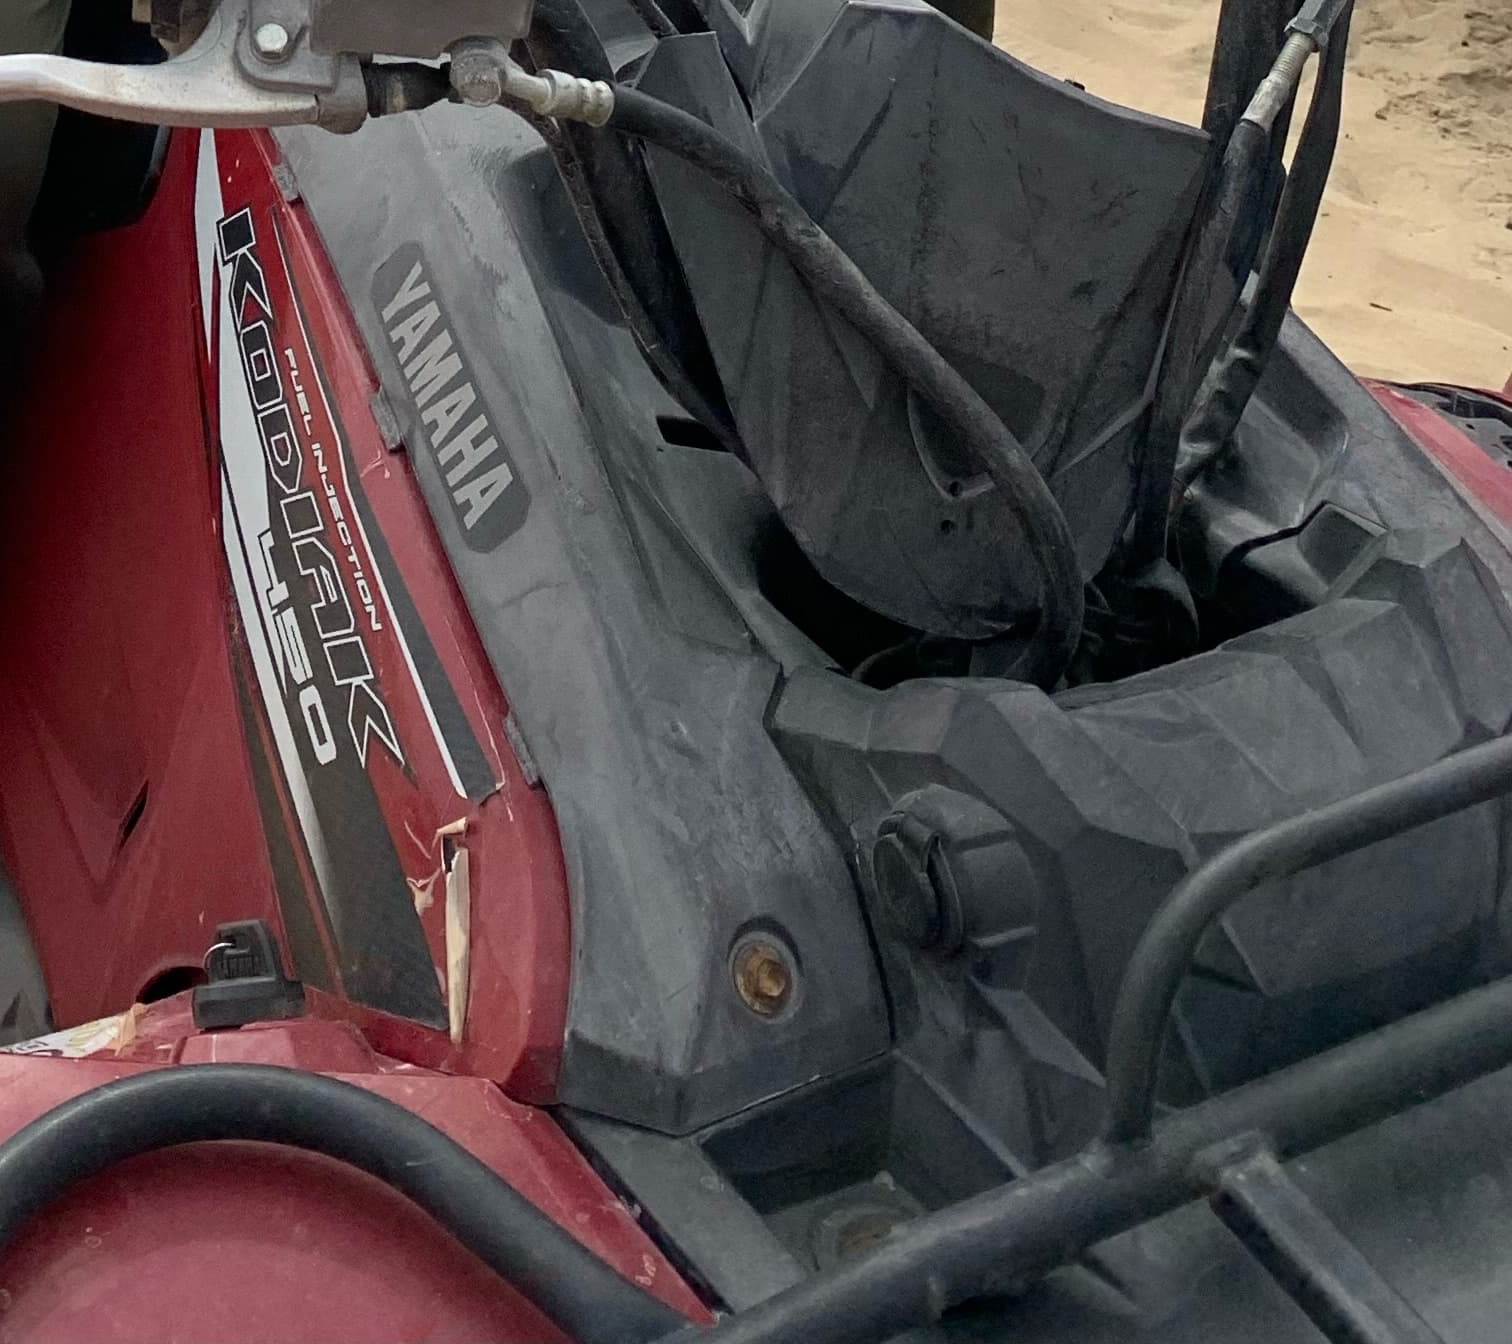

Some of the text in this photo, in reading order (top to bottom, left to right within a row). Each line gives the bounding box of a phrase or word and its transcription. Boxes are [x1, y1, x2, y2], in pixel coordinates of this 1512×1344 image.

[217, 208, 406, 768] KODIAK
[284, 347, 382, 633] FUEL INJECTION
[380, 262, 515, 532] YAMAHA
[258, 530, 335, 765] 450
